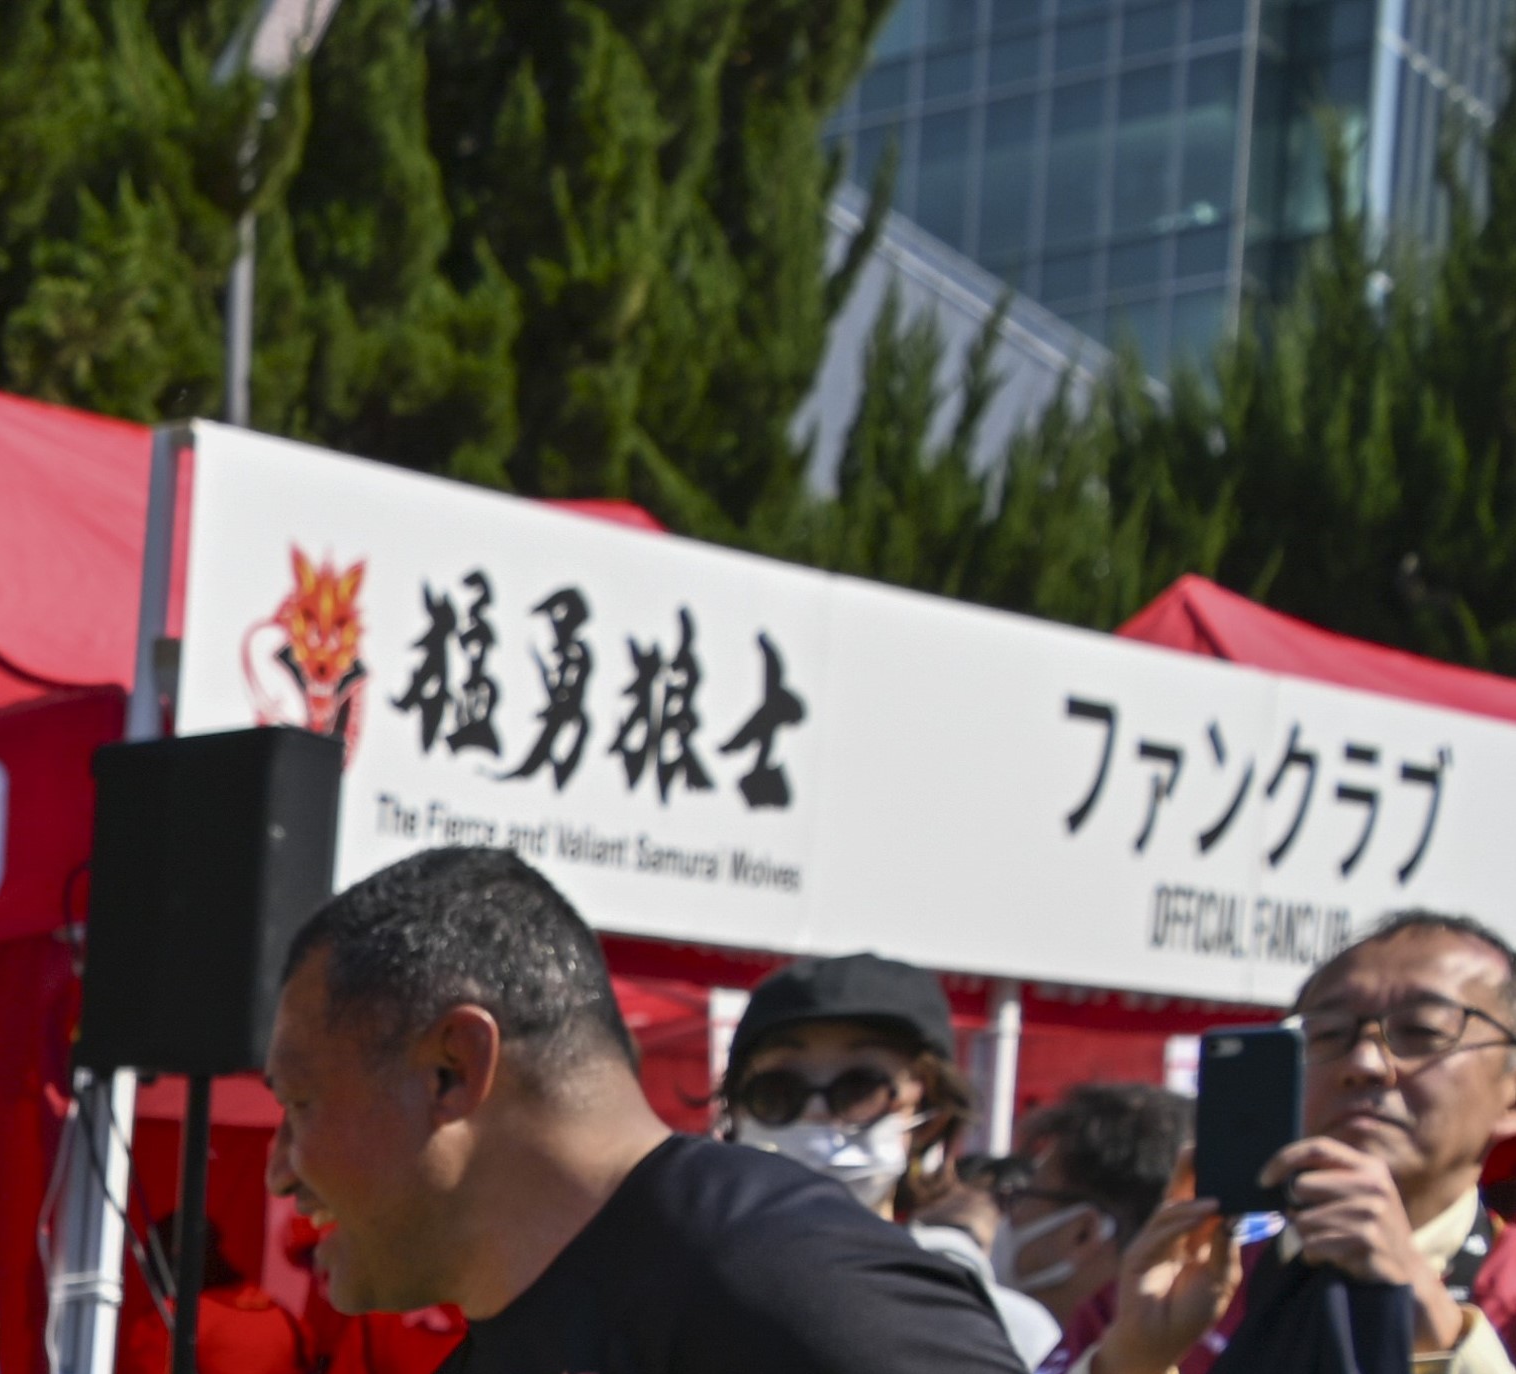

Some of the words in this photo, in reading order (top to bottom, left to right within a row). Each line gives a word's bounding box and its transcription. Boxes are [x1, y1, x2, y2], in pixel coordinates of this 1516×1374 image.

[389, 568, 809, 809] 猛勇狼士
[376, 793, 417, 836] The
[507, 815, 548, 855] and
[557, 820, 626, 868] Valiant
[637, 834, 722, 879] Samurai
[730, 851, 801, 892] Wolves
[1060, 694, 1454, 887] ファンクラブ
[1149, 884, 1248, 959] OFFICIAL
